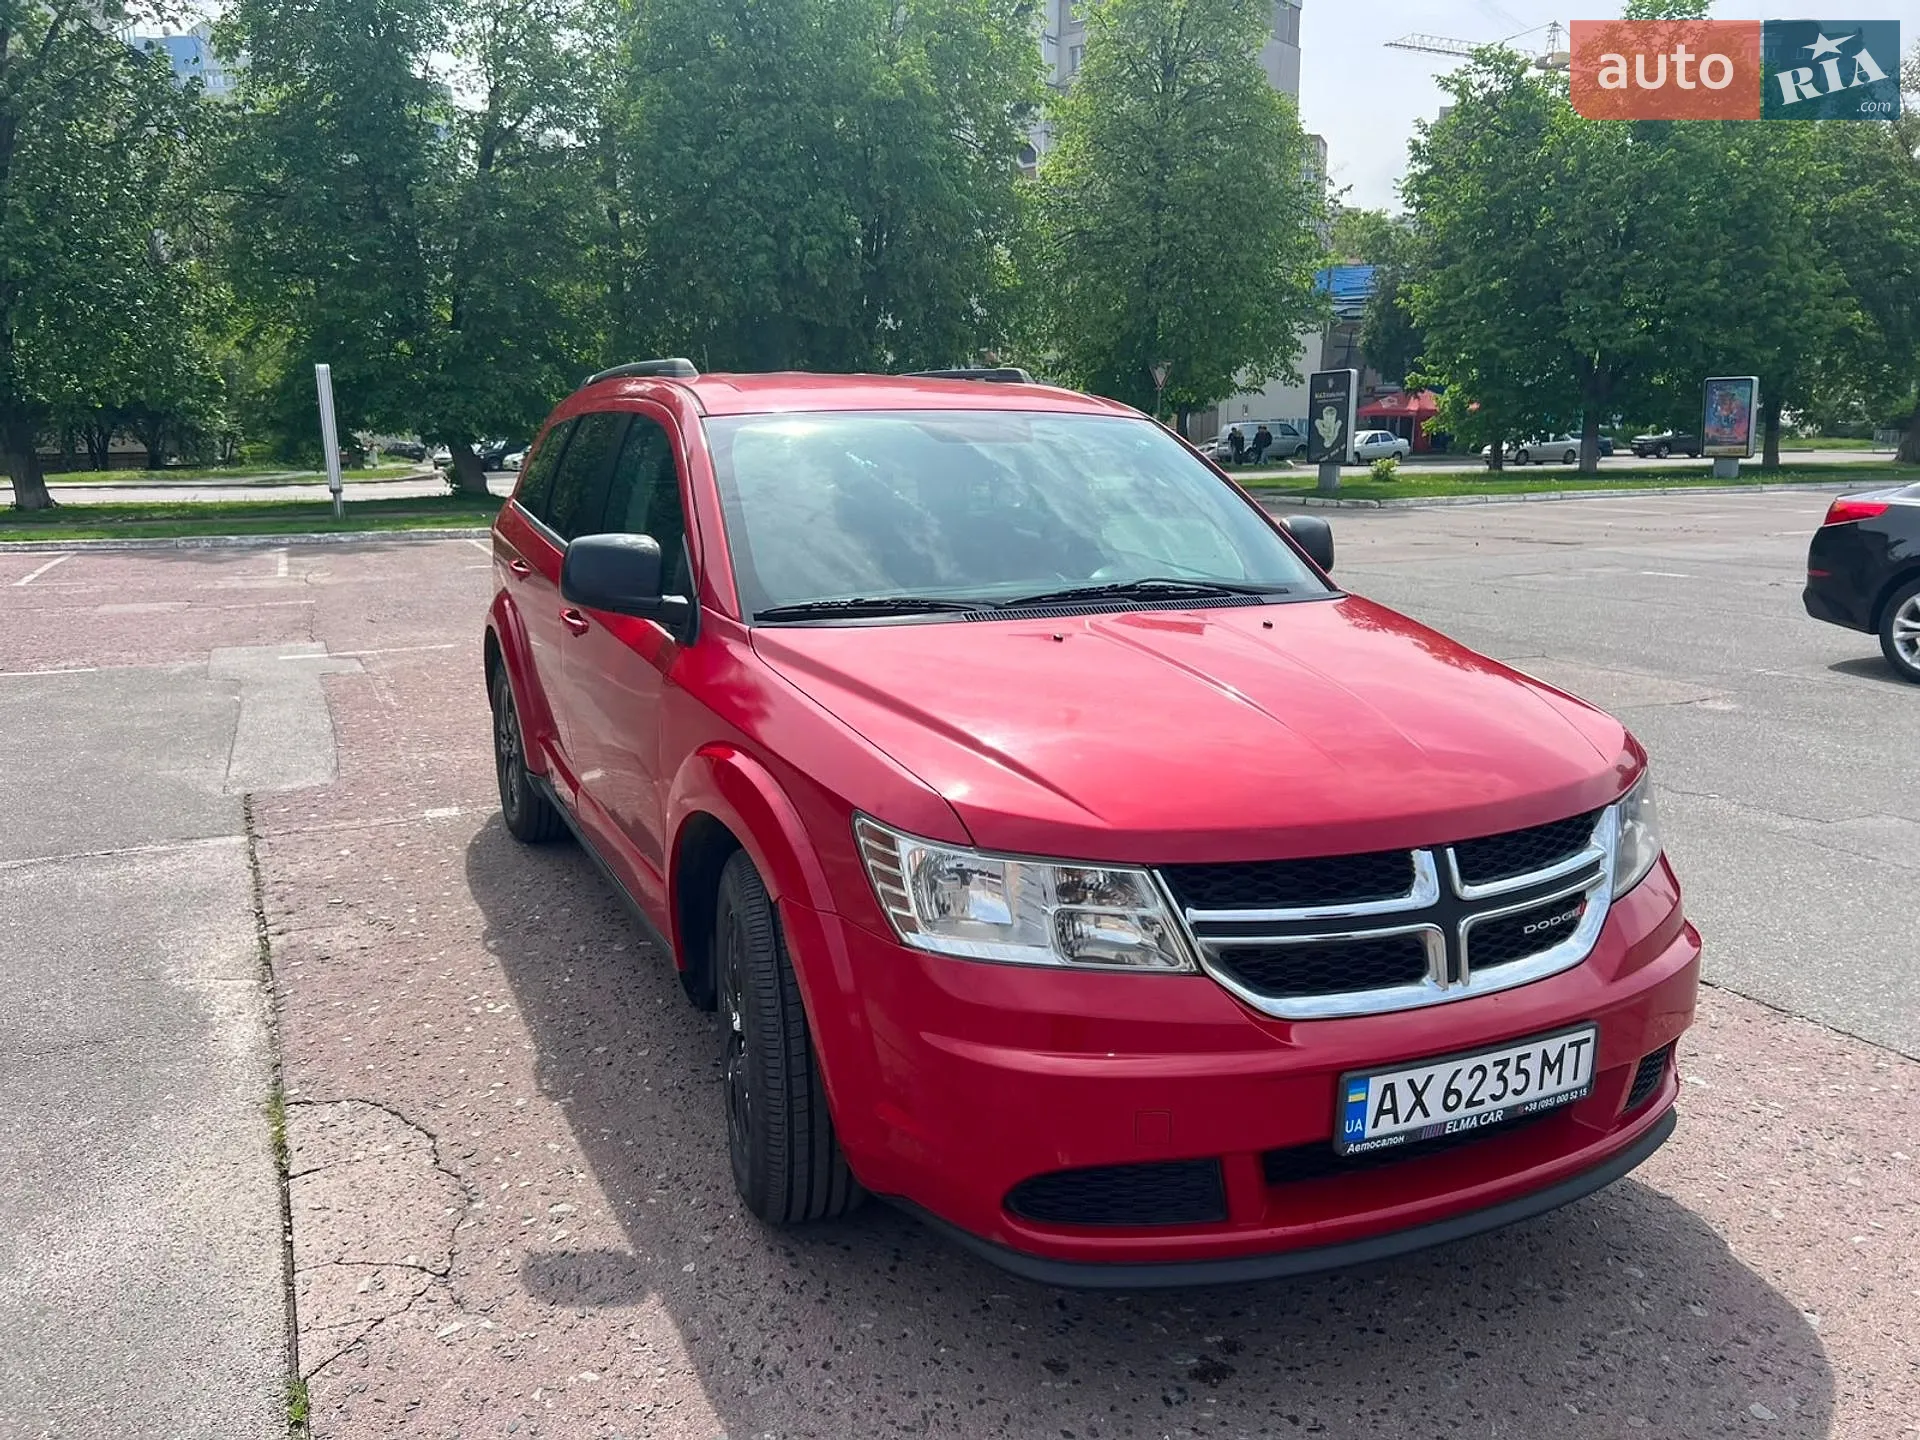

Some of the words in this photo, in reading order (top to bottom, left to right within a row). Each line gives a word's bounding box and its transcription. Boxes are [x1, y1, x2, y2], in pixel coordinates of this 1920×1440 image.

[1371, 1074, 1434, 1129] AX
[1442, 1053, 1531, 1112] 6235
[1538, 1037, 1591, 1091] MT
[1345, 1118, 1363, 1133] UA
[1445, 1116, 1478, 1134] ELMA
[1479, 1110, 1504, 1126] CAR
[1346, 1135, 1405, 1153] Автосалон
